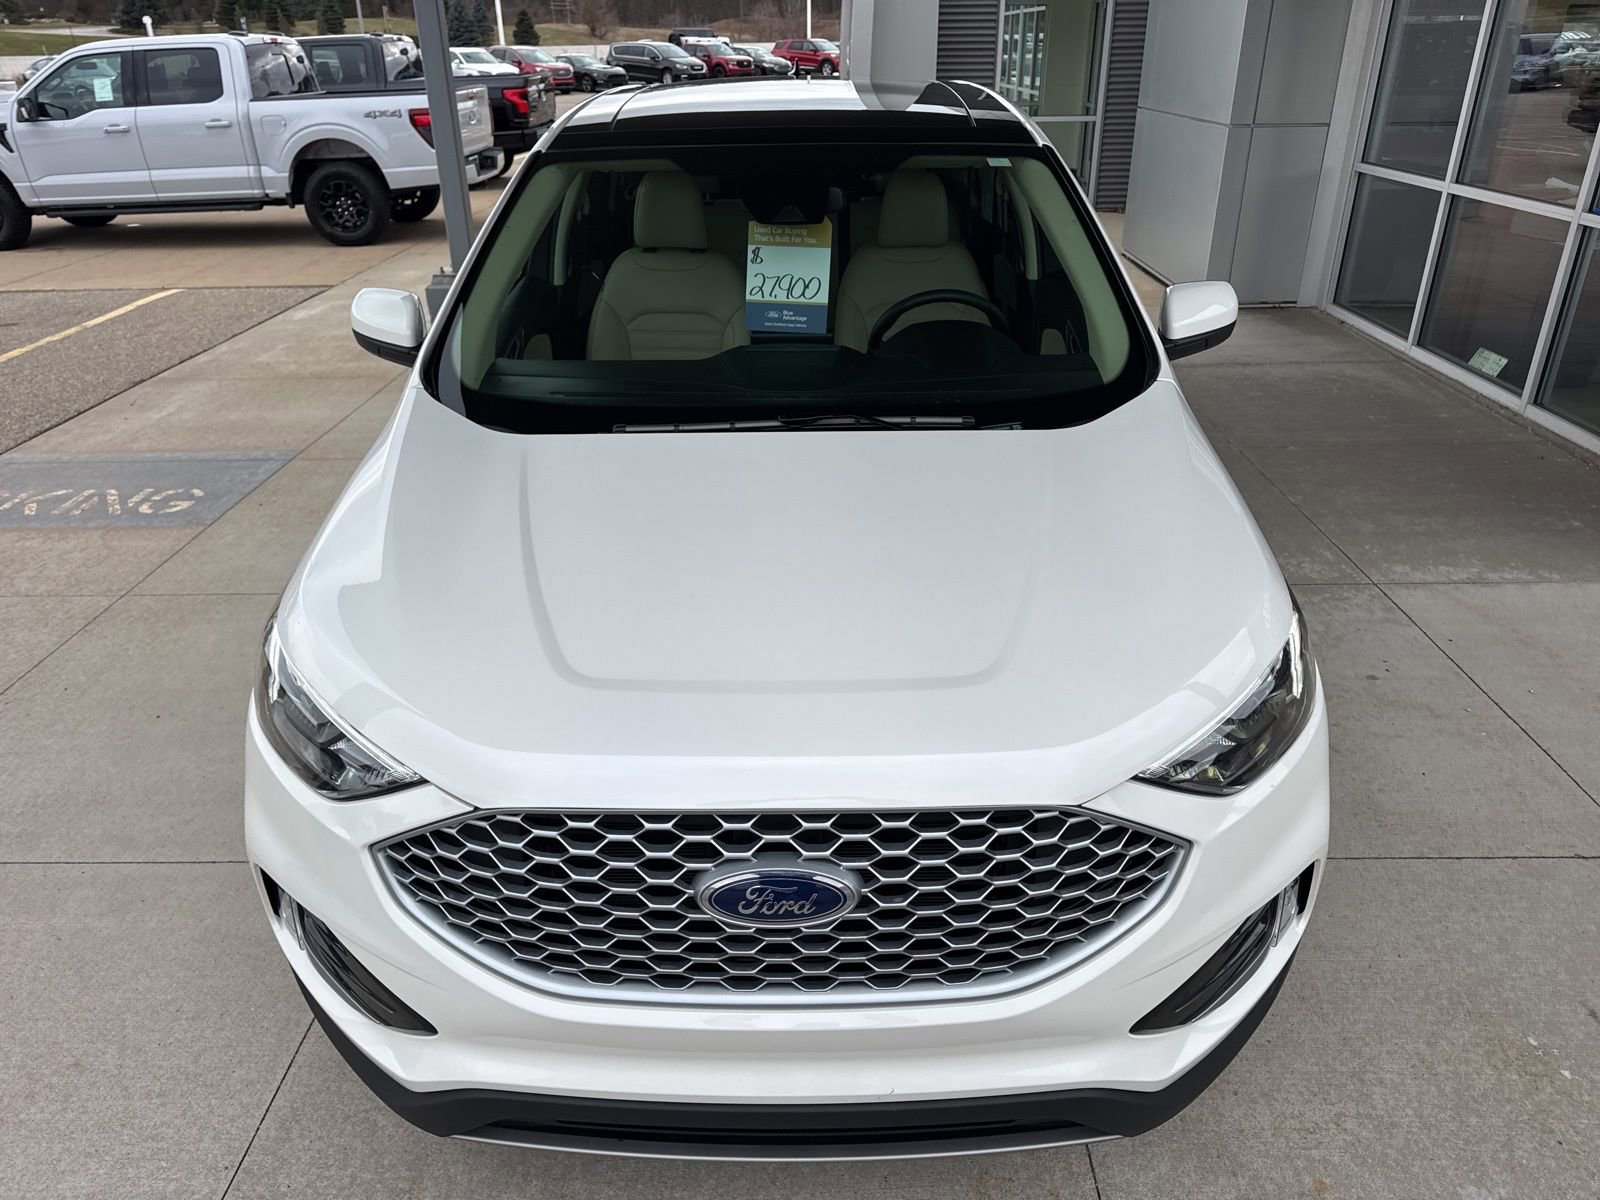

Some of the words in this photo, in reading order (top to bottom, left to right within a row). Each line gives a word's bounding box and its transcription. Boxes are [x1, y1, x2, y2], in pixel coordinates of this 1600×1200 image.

[754, 234, 774, 242] That's
[775, 235, 790, 243] Built
[784, 227, 807, 236] Buying
[750, 246, 764, 265] $
[0, 489, 205, 515] KING
[738, 885, 818, 915] Ford
